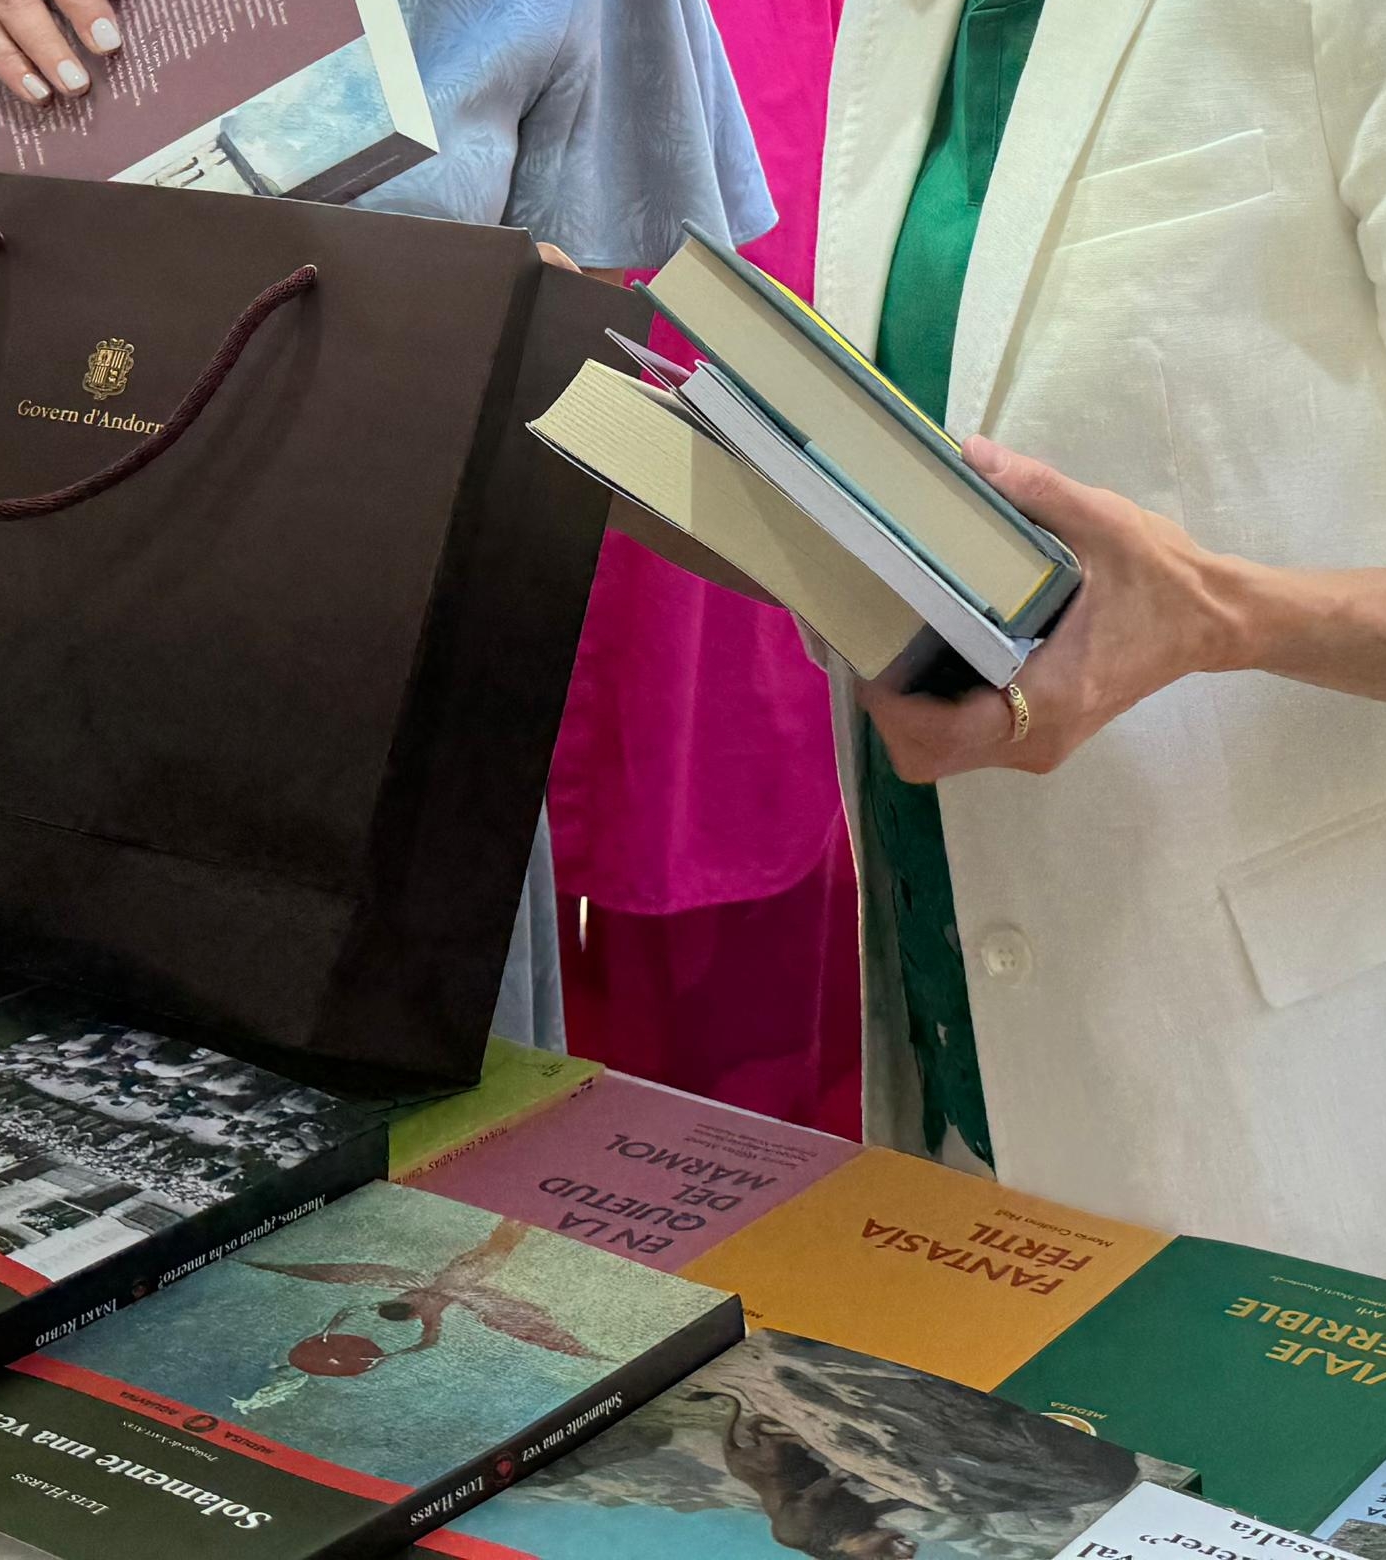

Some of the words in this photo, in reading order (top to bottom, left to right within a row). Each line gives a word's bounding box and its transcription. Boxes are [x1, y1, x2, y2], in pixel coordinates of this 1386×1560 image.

[16, 397, 79, 425] Govern
[83, 406, 166, 436] d'Andorr
[604, 1133, 778, 1193] MÁRMOL
[538, 1176, 707, 1232] QUIETUD
[671, 1182, 743, 1213] DEL
[556, 1211, 610, 1239] LA
[208, 1242, 224, 1262] ha
[224, 1238, 239, 1258] os
[620, 1227, 674, 1255] EN
[968, 1222, 1093, 1272] FÉRTIL
[156, 1252, 207, 1290] muerto?
[861, 1218, 1064, 1296] FANTASÍA
[34, 1318, 77, 1348] RUBIO
[565, 1391, 623, 1438] Solamente
[1048, 1401, 1108, 1421] MEDUSA
[32, 1430, 96, 1460] una
[520, 1444, 541, 1462] vez
[542, 1428, 564, 1449] una
[10, 1472, 69, 1499] HARSS
[94, 1454, 273, 1529] Solamente
[455, 1475, 484, 1500] LUIS
[67, 1493, 109, 1515] LUIS
[410, 1492, 454, 1526] HARSS
